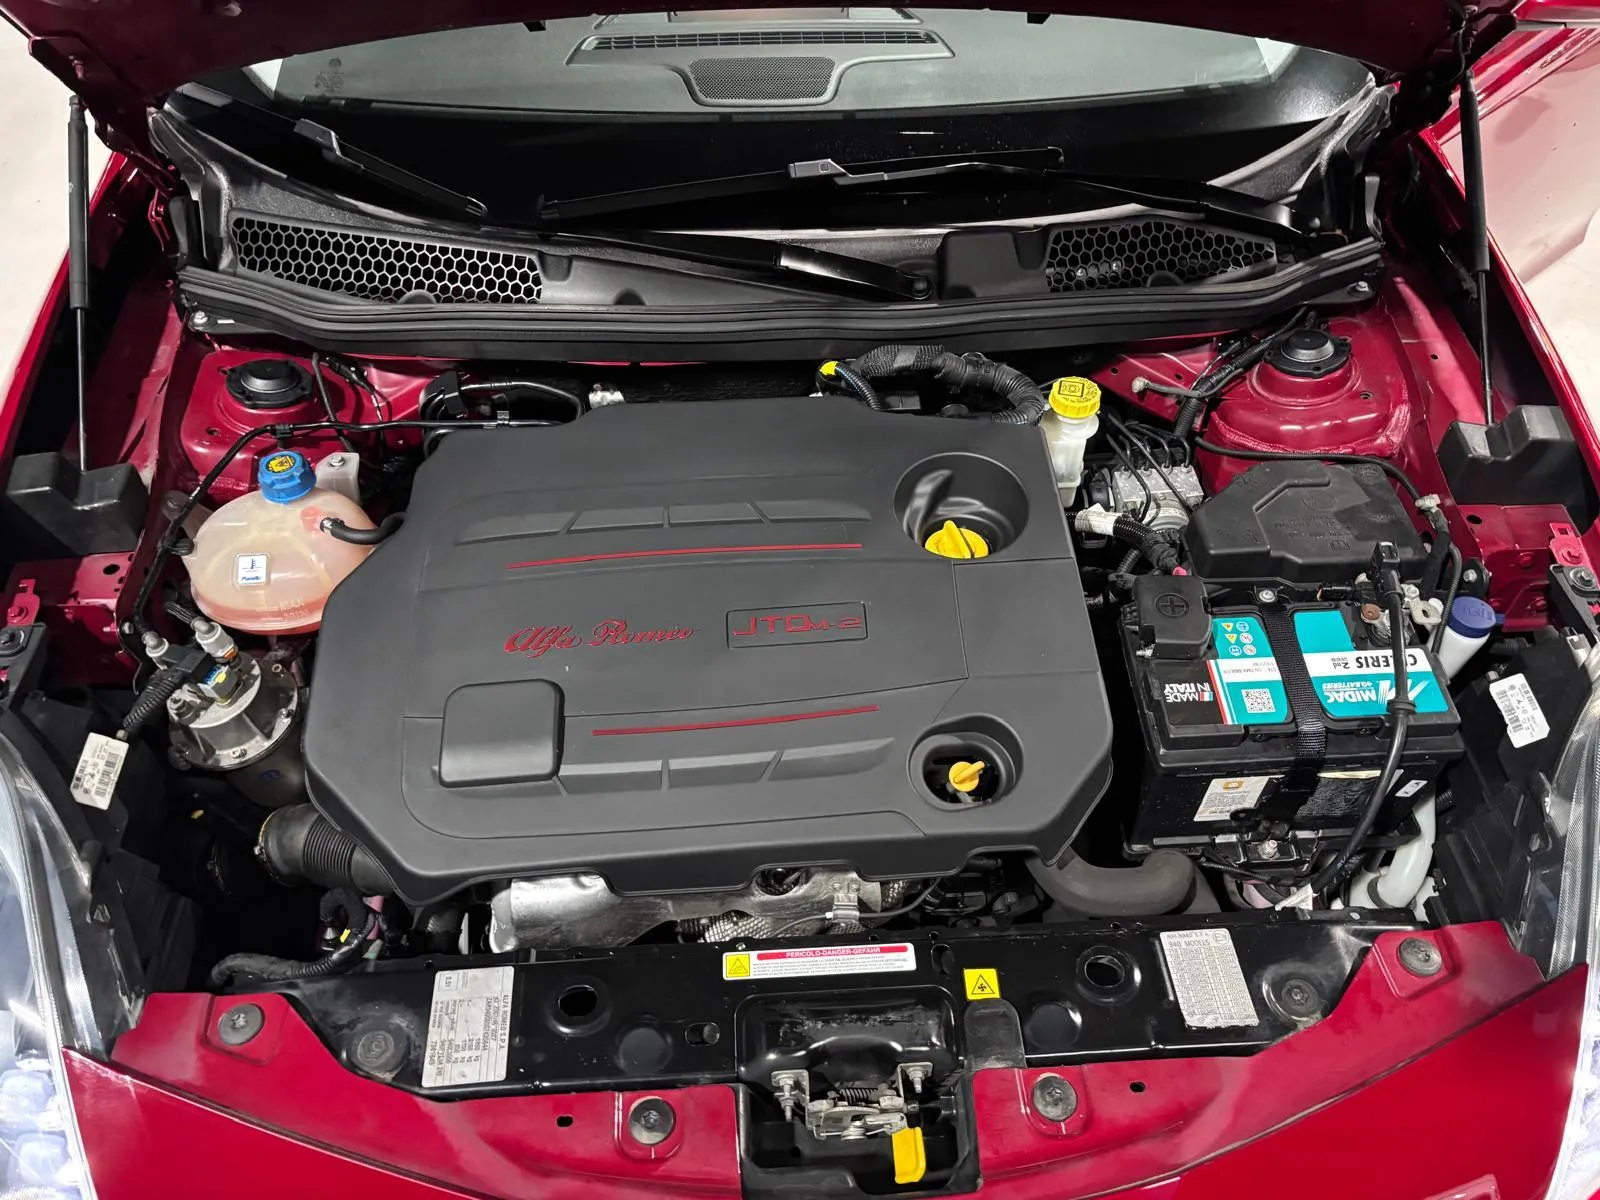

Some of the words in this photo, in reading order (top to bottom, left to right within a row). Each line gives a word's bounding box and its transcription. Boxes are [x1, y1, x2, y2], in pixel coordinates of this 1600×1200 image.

[504, 625, 583, 658] Alfa
[588, 619, 701, 647] Romeo
[1356, 654, 1418, 668] CERIS
[1164, 683, 1196, 694] ITALY
[1197, 682, 1210, 692] IN
[1166, 692, 1198, 703] MADE
[1324, 689, 1377, 704] MIDAC
[786, 947, 881, 958] PERICOLO-DANGER-GEFAHR
